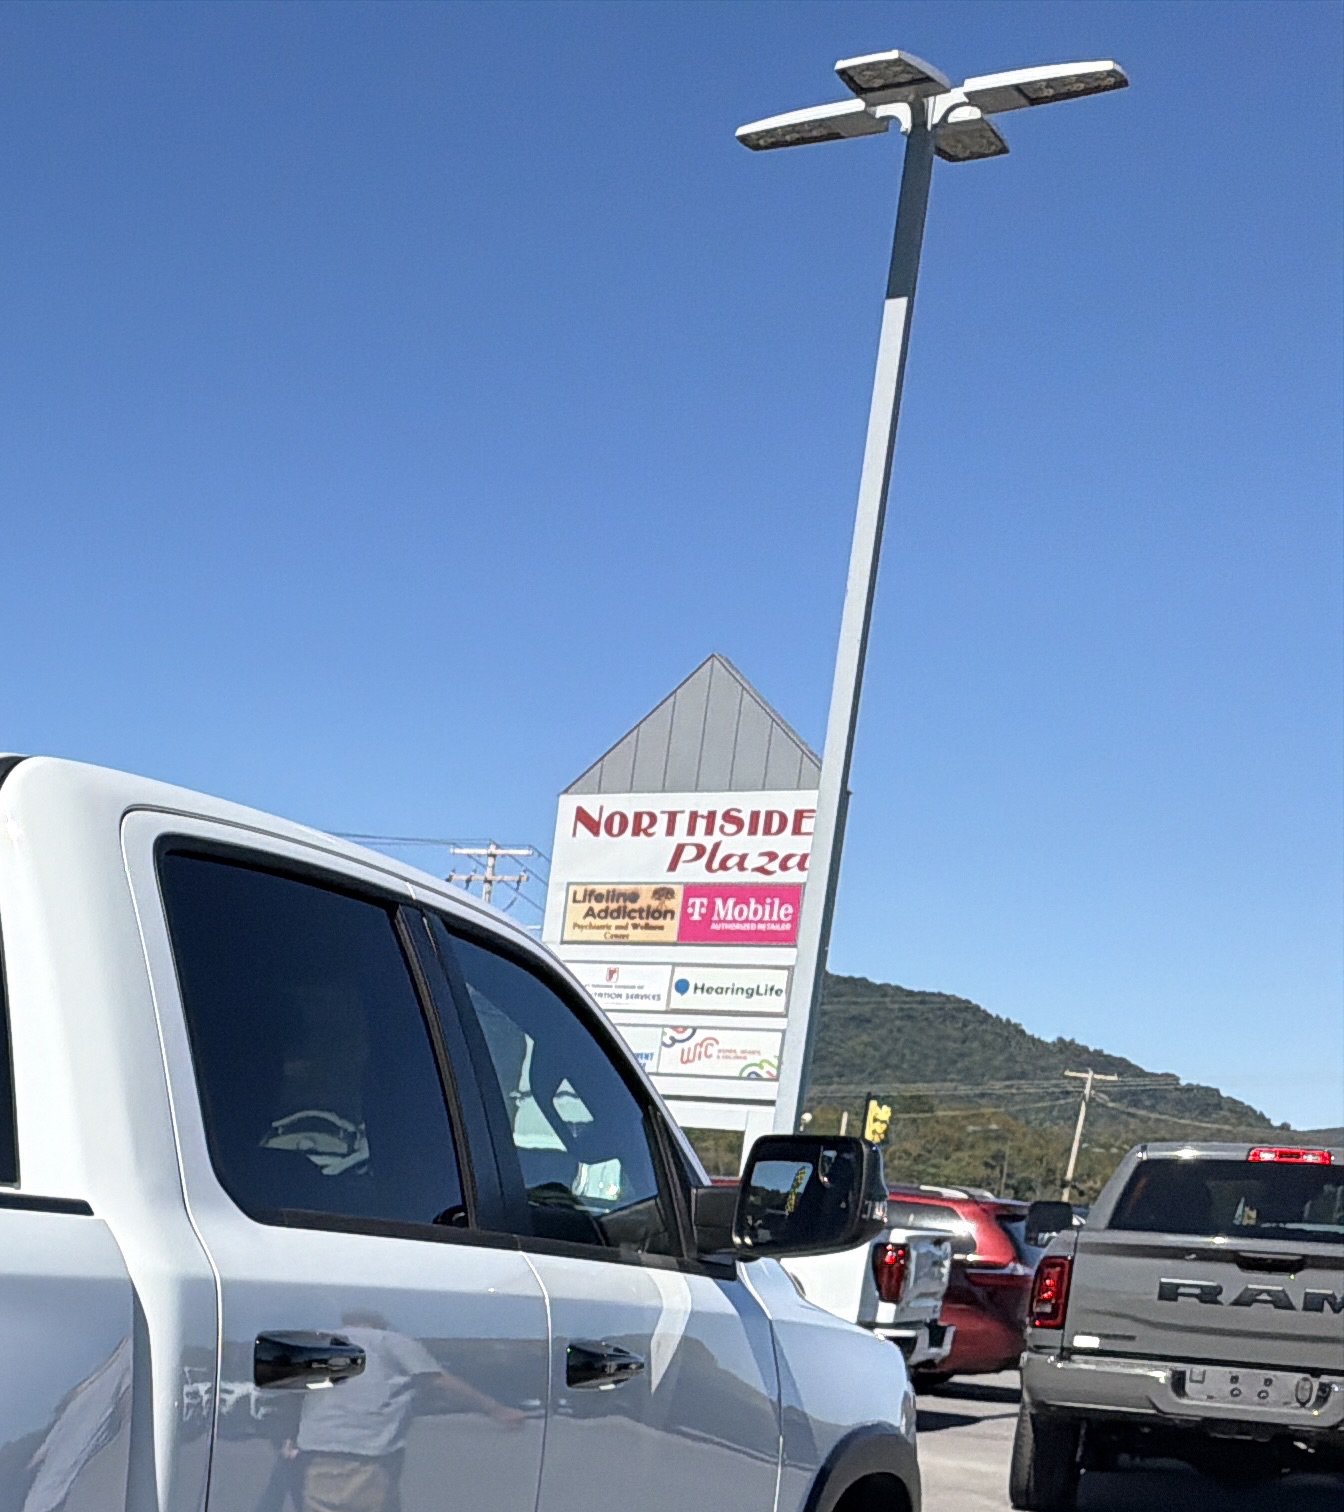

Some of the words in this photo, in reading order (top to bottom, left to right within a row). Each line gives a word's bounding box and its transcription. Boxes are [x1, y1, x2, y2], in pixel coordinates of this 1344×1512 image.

[572, 805, 816, 838] NORTHSIDE
[666, 840, 811, 876] Plaza
[572, 888, 640, 904] Lifeline
[583, 905, 675, 921] Addiction
[712, 897, 794, 922] Mobile
[693, 982, 784, 999] HearingLife
